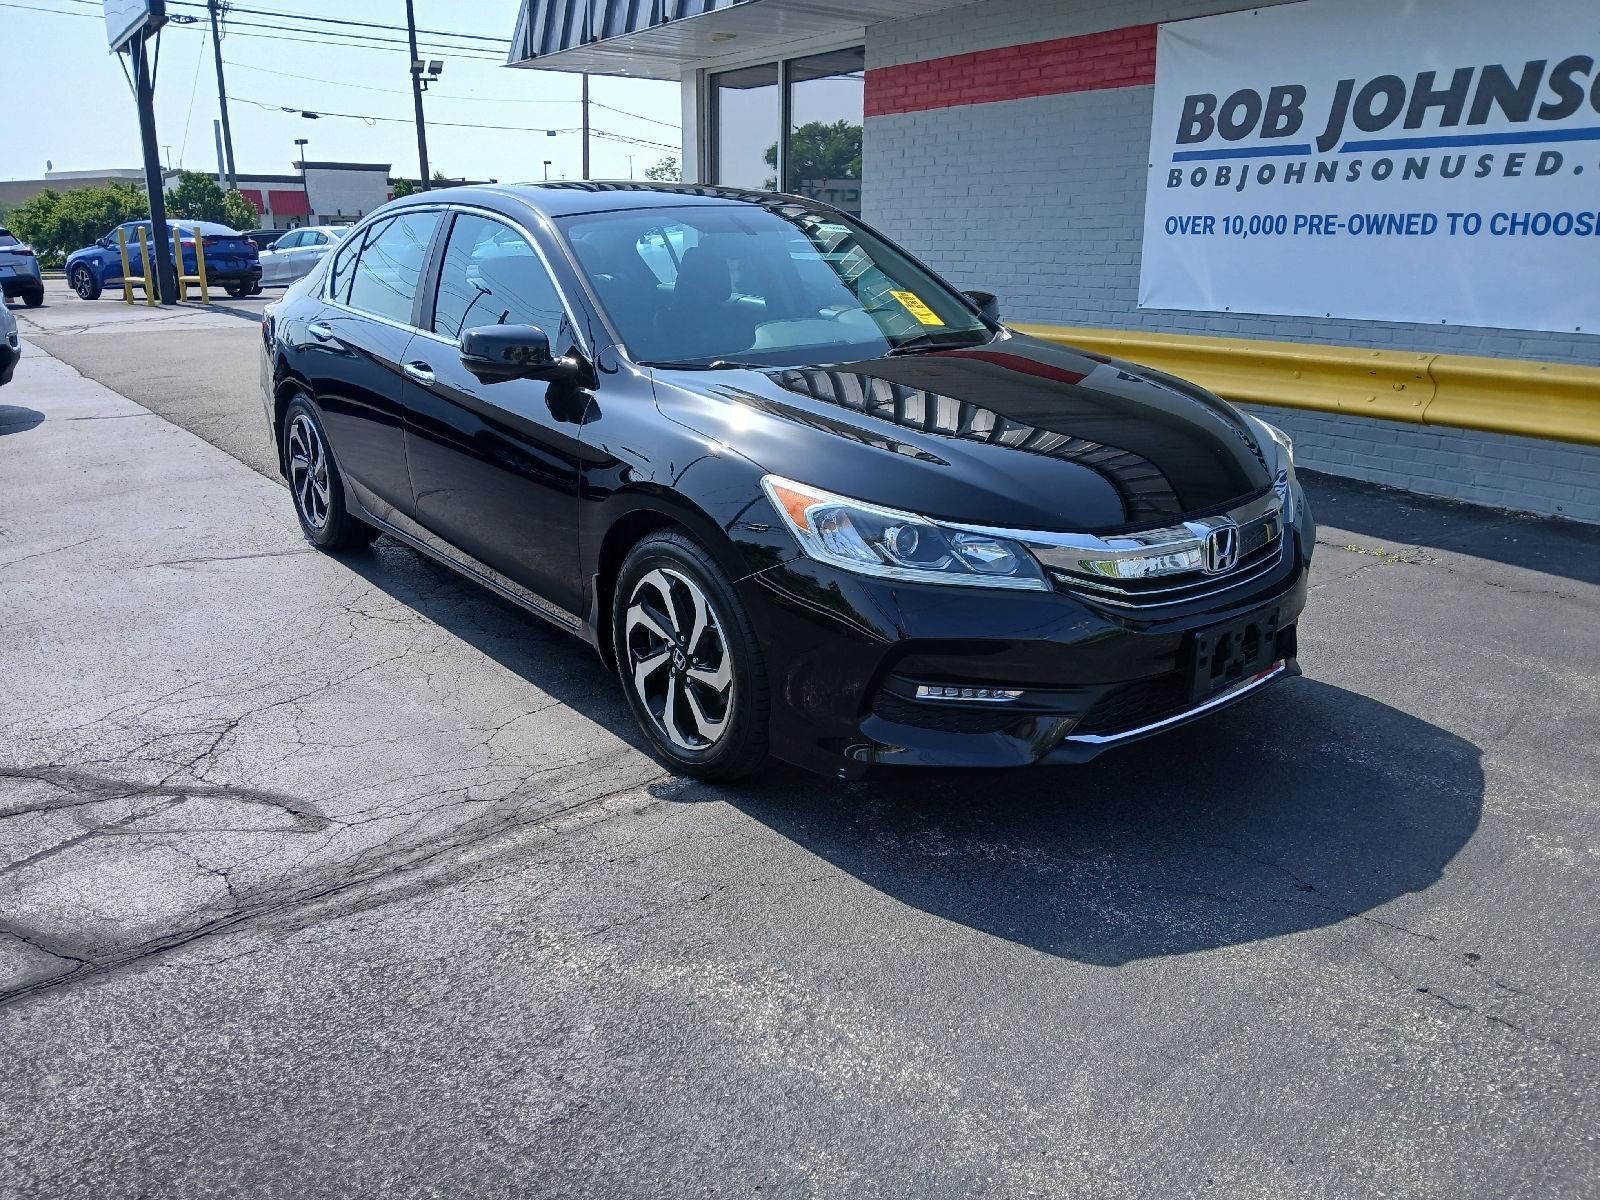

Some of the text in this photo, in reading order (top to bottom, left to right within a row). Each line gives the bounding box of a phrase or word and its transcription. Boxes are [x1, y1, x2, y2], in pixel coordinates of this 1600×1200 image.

[1175, 55, 1600, 153] BOB JOHNS
[1166, 151, 1600, 192] BOBJOHNSONUSED.
[1165, 215, 1216, 236] OVER
[1222, 214, 1288, 239] 10,000
[1293, 213, 1438, 236] PRE-OWNED
[1446, 212, 1482, 236] TO
